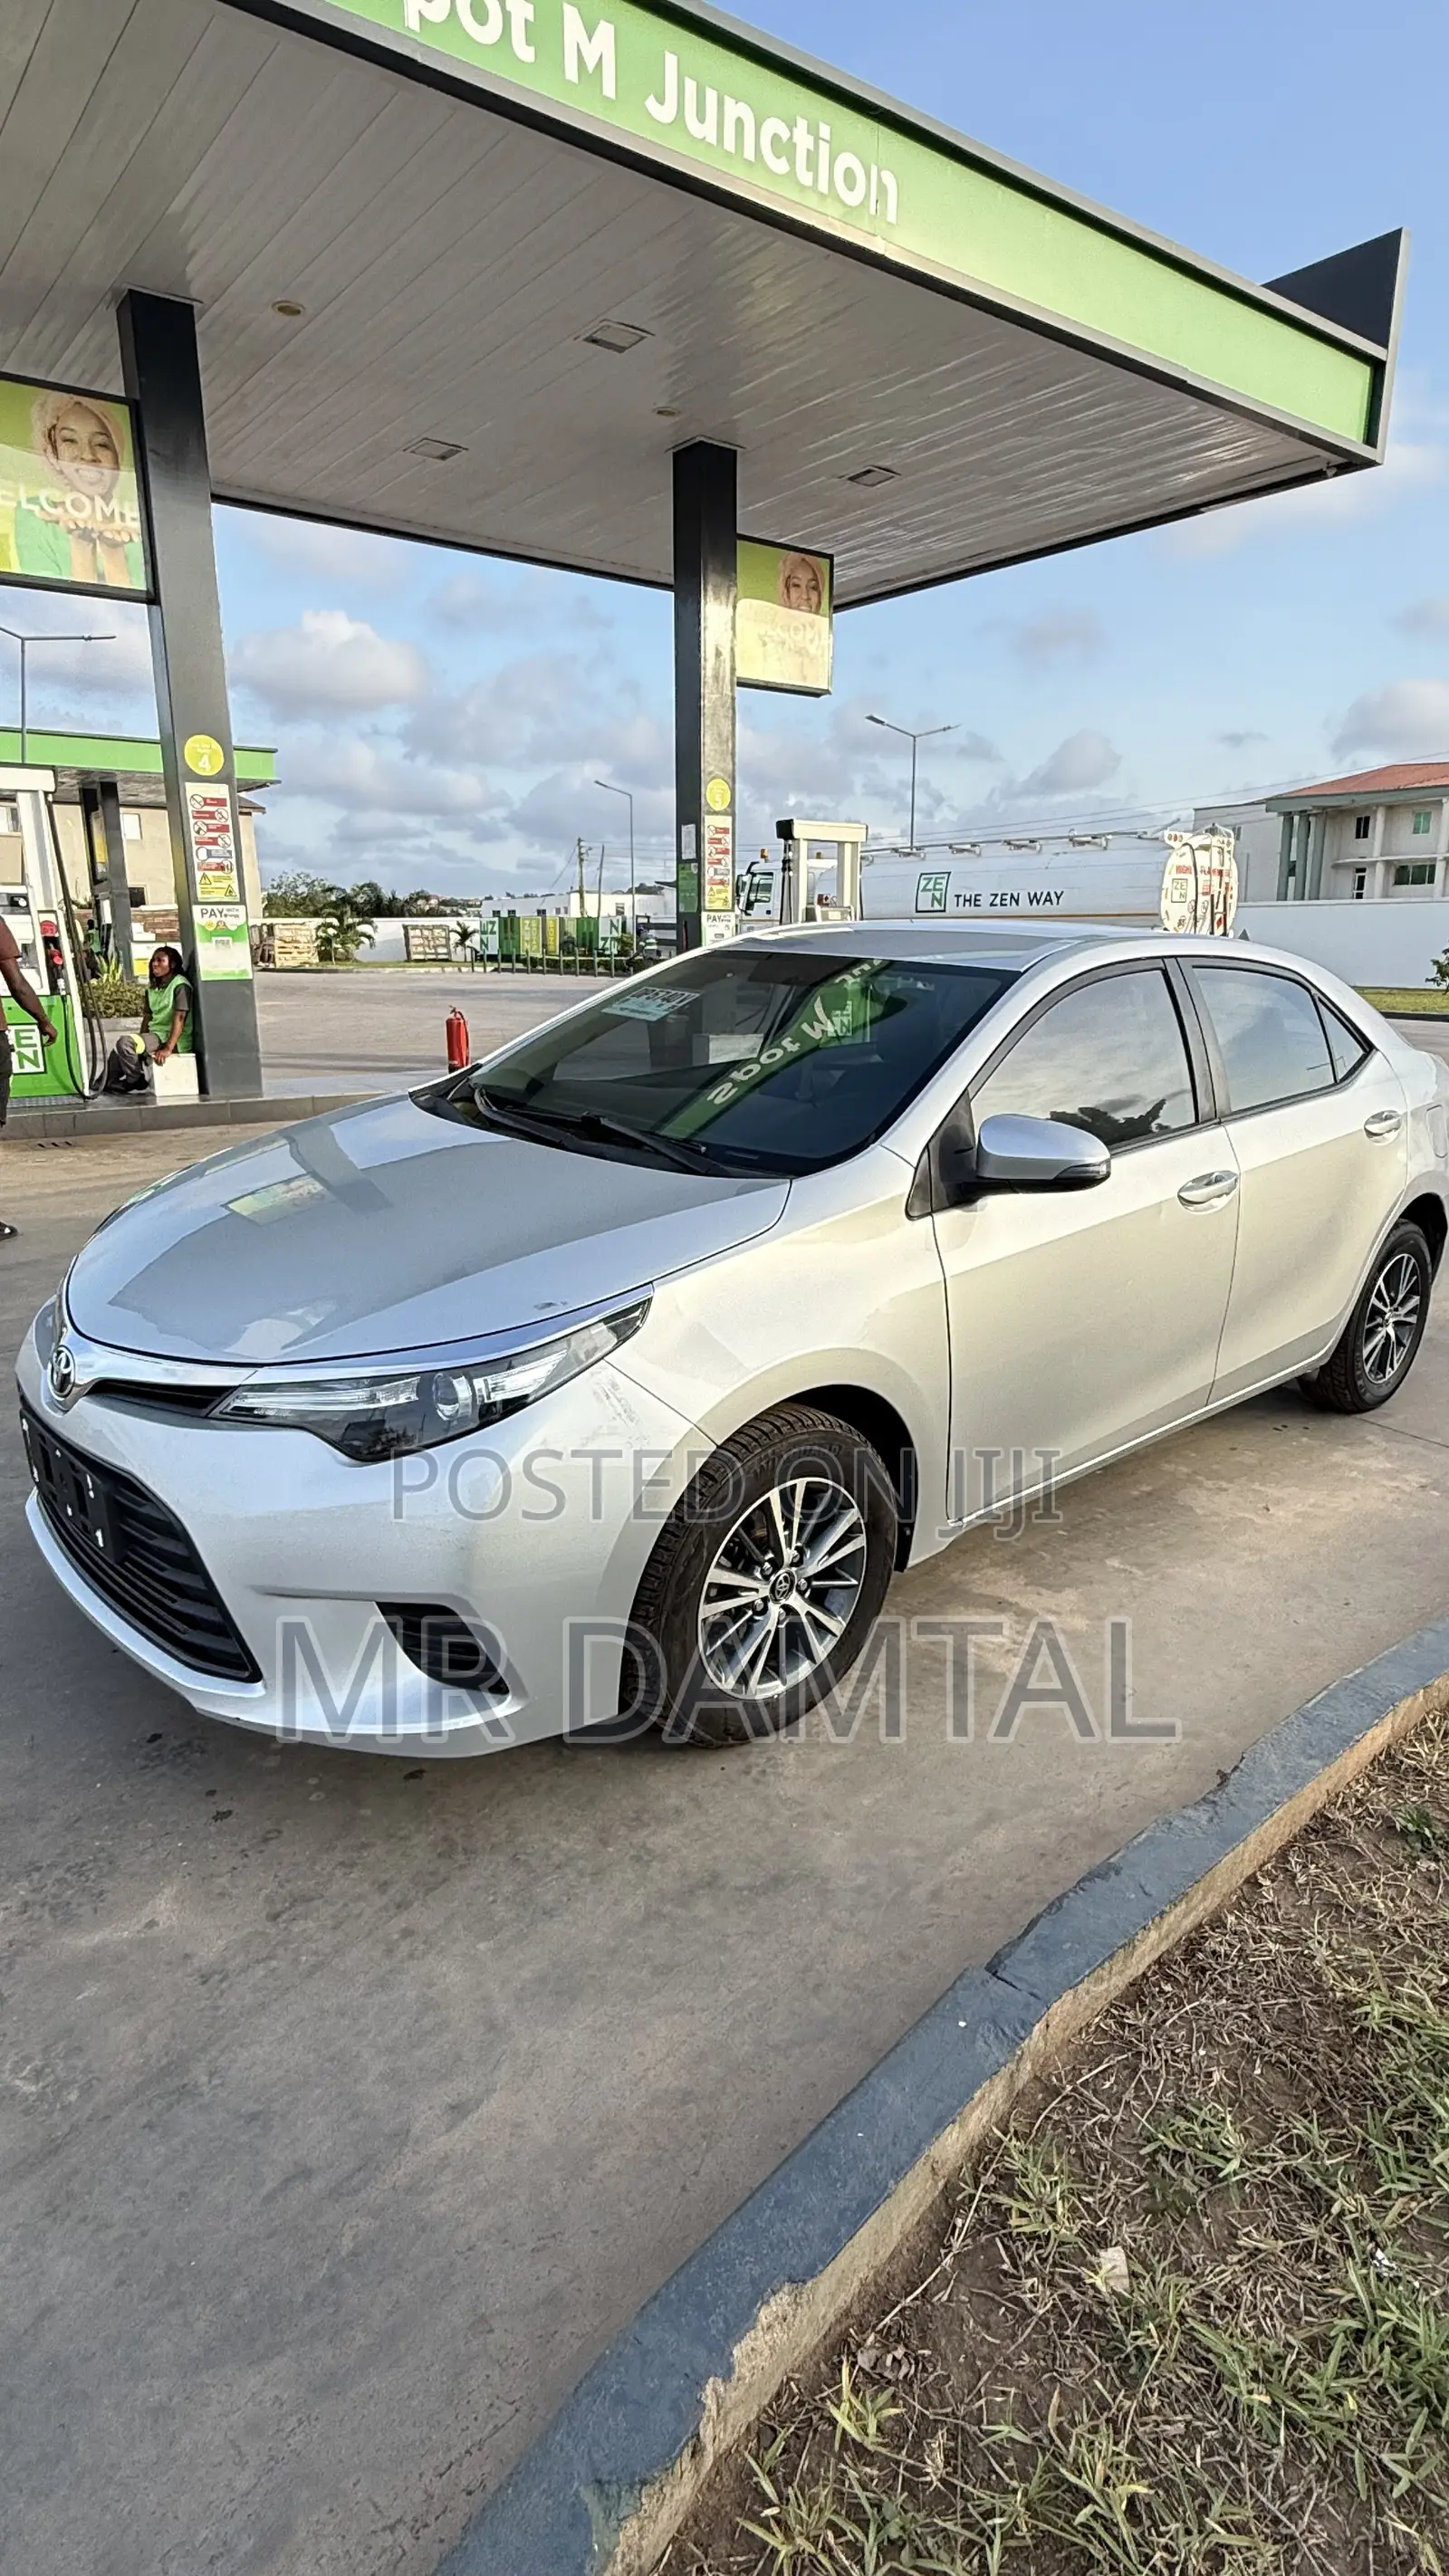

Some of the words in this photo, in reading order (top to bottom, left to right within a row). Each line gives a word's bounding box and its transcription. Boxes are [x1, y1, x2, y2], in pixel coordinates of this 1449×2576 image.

[562, 2, 617, 101] M
[644, 51, 898, 225] Junction
[197, 753, 212, 772] 4
[954, 894, 983, 907] THE
[989, 892, 1021, 907] ZEN
[1027, 890, 1065, 906] WAY
[200, 907, 224, 919] PAY
[706, 914, 722, 923] PAY
